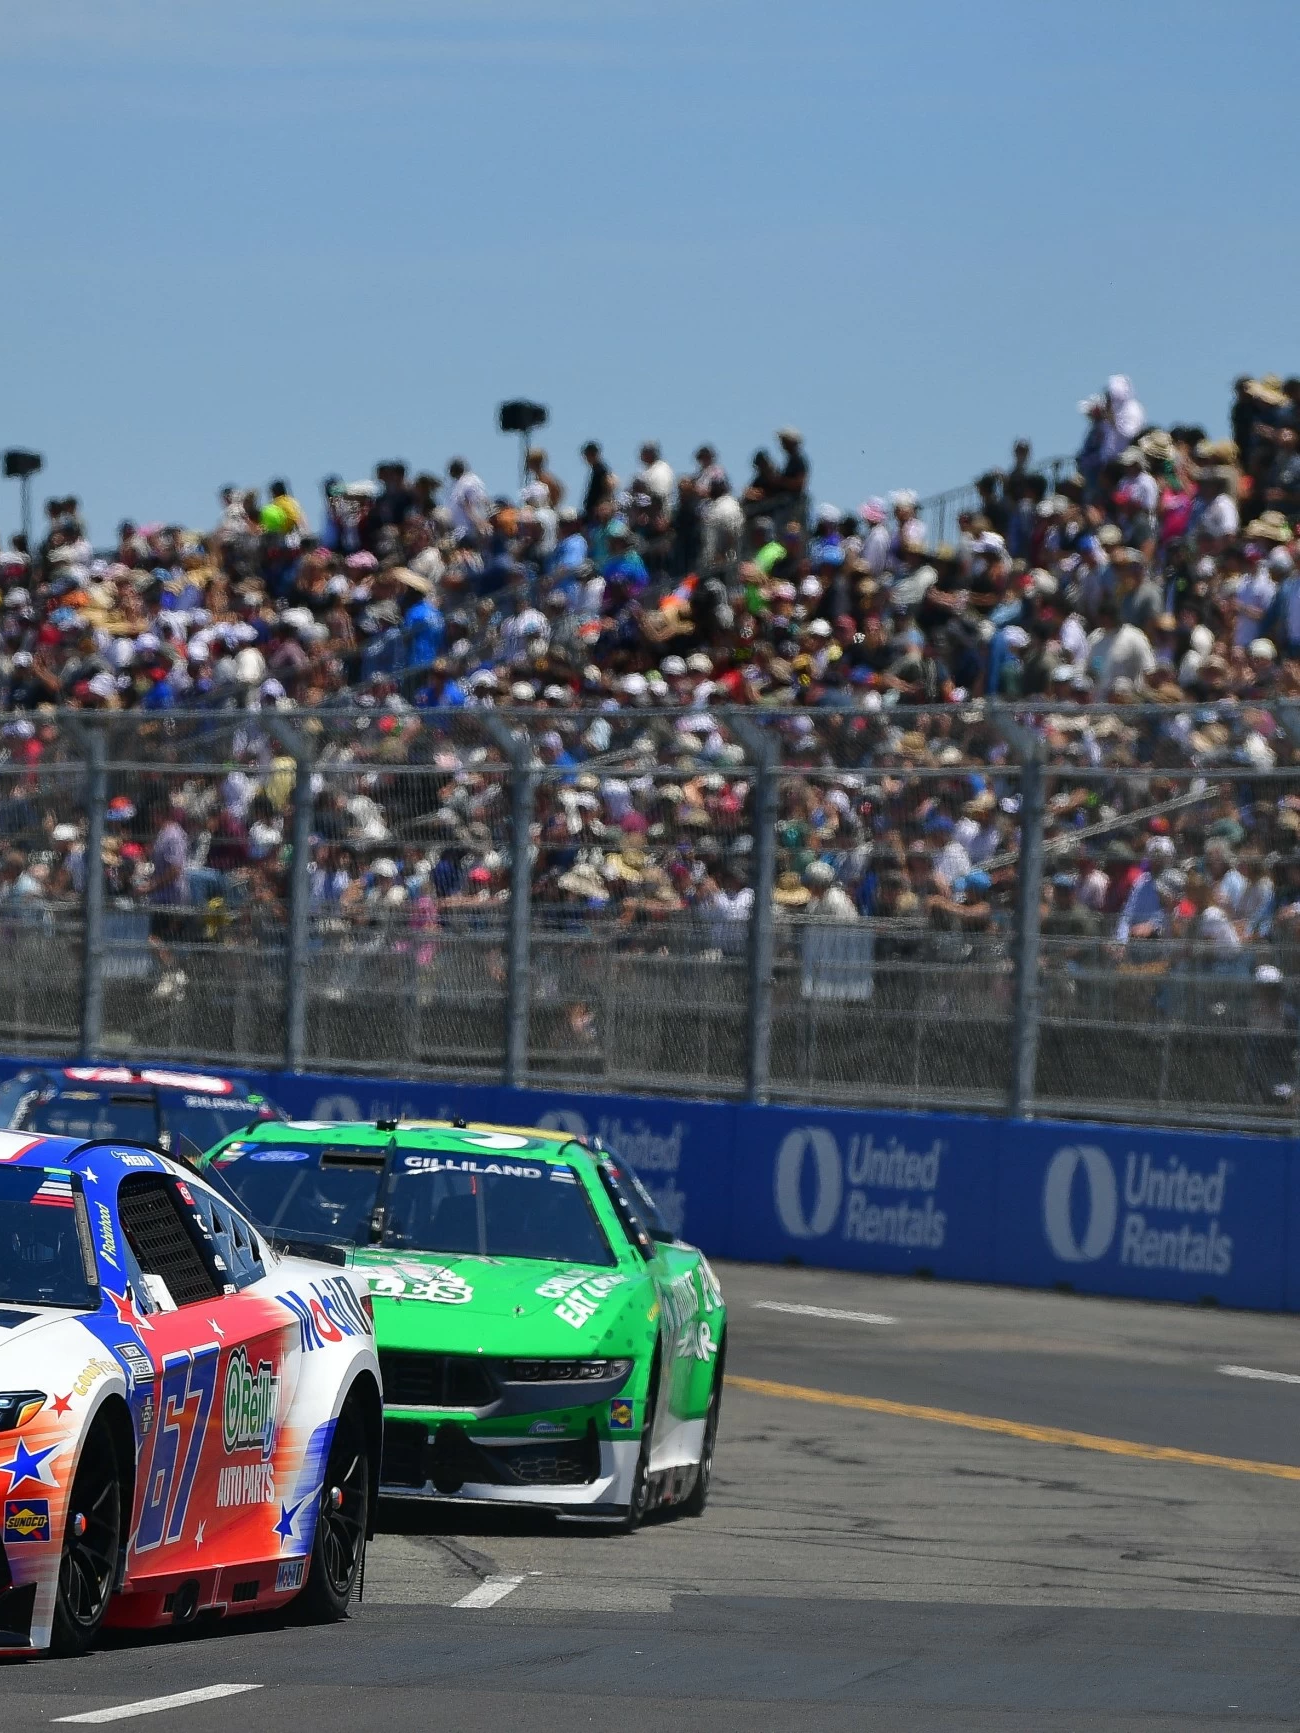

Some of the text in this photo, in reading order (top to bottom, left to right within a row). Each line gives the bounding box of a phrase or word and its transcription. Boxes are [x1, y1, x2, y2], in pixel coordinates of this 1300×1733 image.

[122, 1155, 154, 1167] HEIM
[404, 1156, 542, 1179] GILLILAND
[95, 1201, 116, 1257] Robinhood
[275, 1279, 363, 1353] Mobil
[554, 1289, 600, 1329] EAT
[224, 1348, 280, 1458] O'Reilly
[135, 1342, 220, 1555] 67
[216, 1463, 275, 1508] AUTO PARTS
[7, 1515, 46, 1528] SUNOCO
